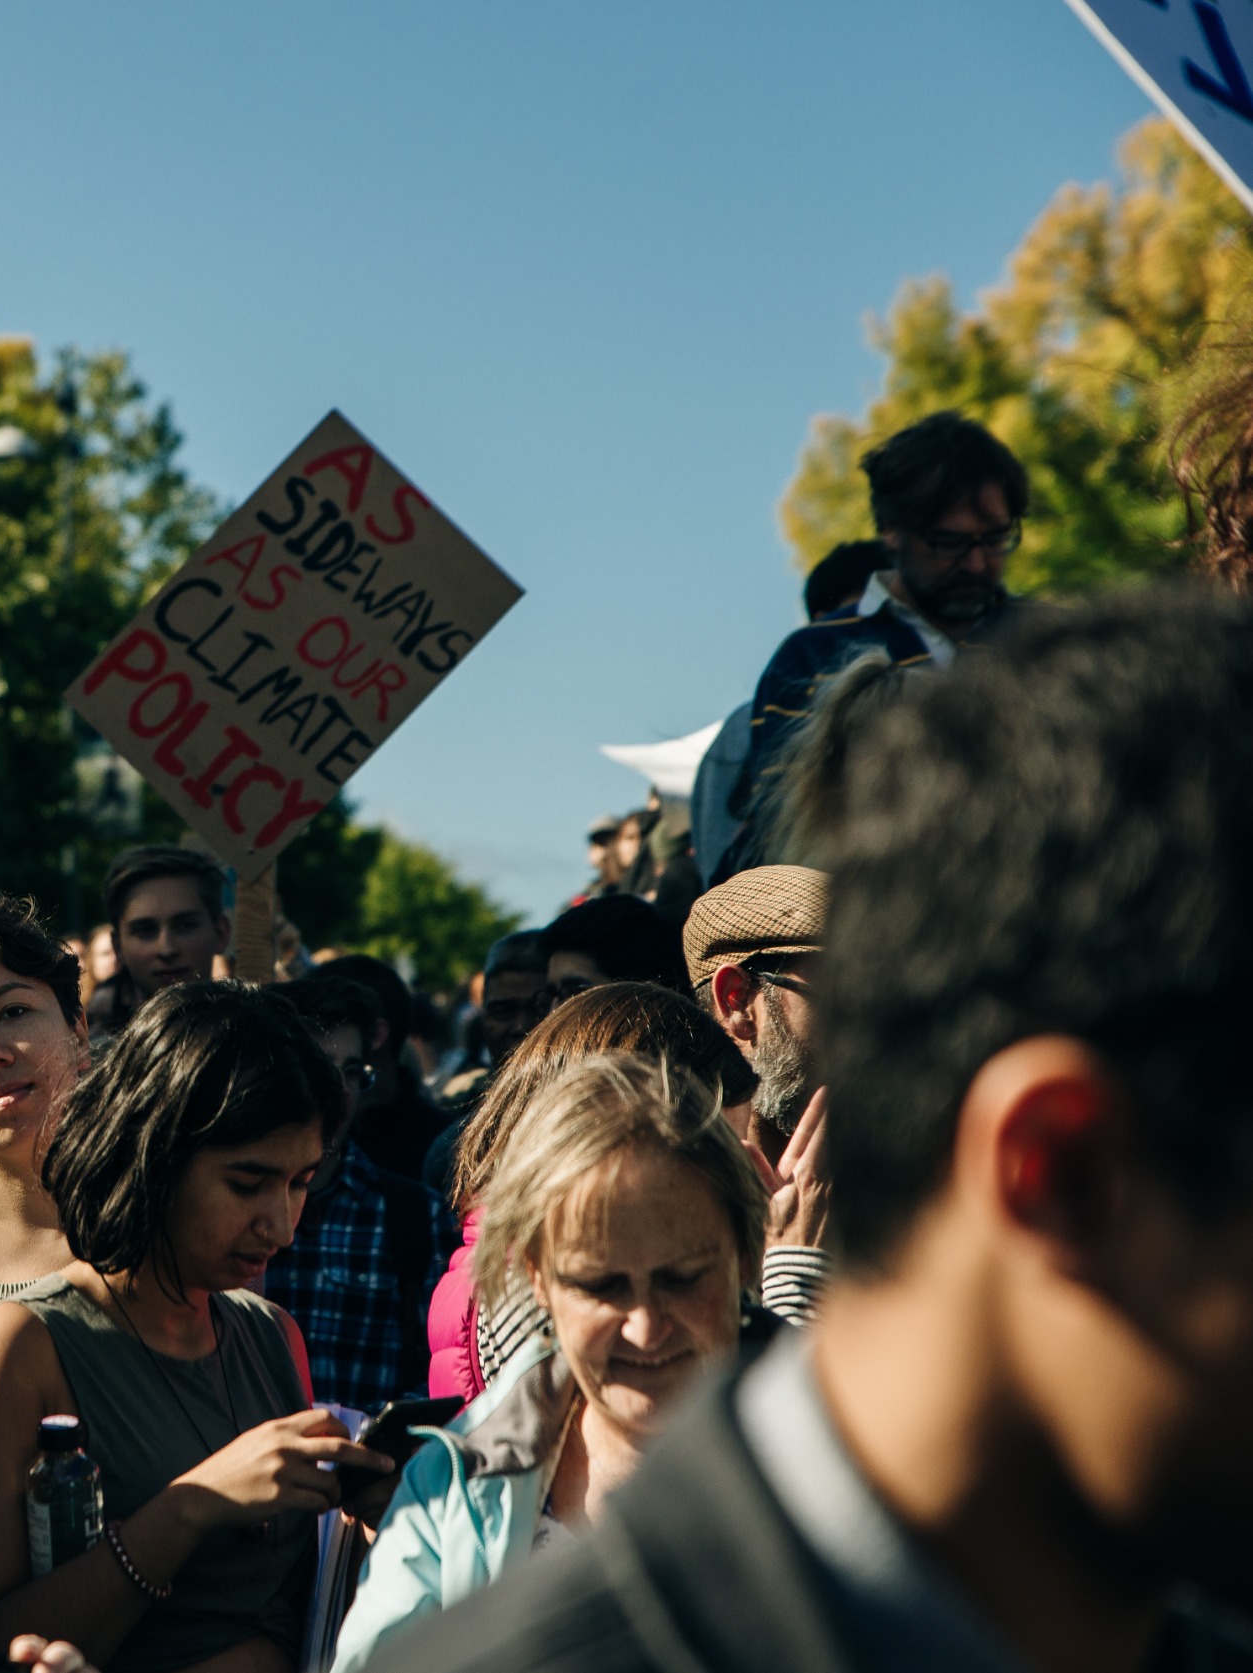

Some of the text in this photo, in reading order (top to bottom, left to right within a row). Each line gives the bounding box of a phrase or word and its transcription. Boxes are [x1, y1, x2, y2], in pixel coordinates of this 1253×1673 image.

[256, 476, 475, 674] SIDEWAYS
[302, 444, 432, 545] AS
[153, 578, 374, 786] CLIMATE
[204, 533, 408, 722] AS OUR
[83, 628, 327, 848] POLICY
